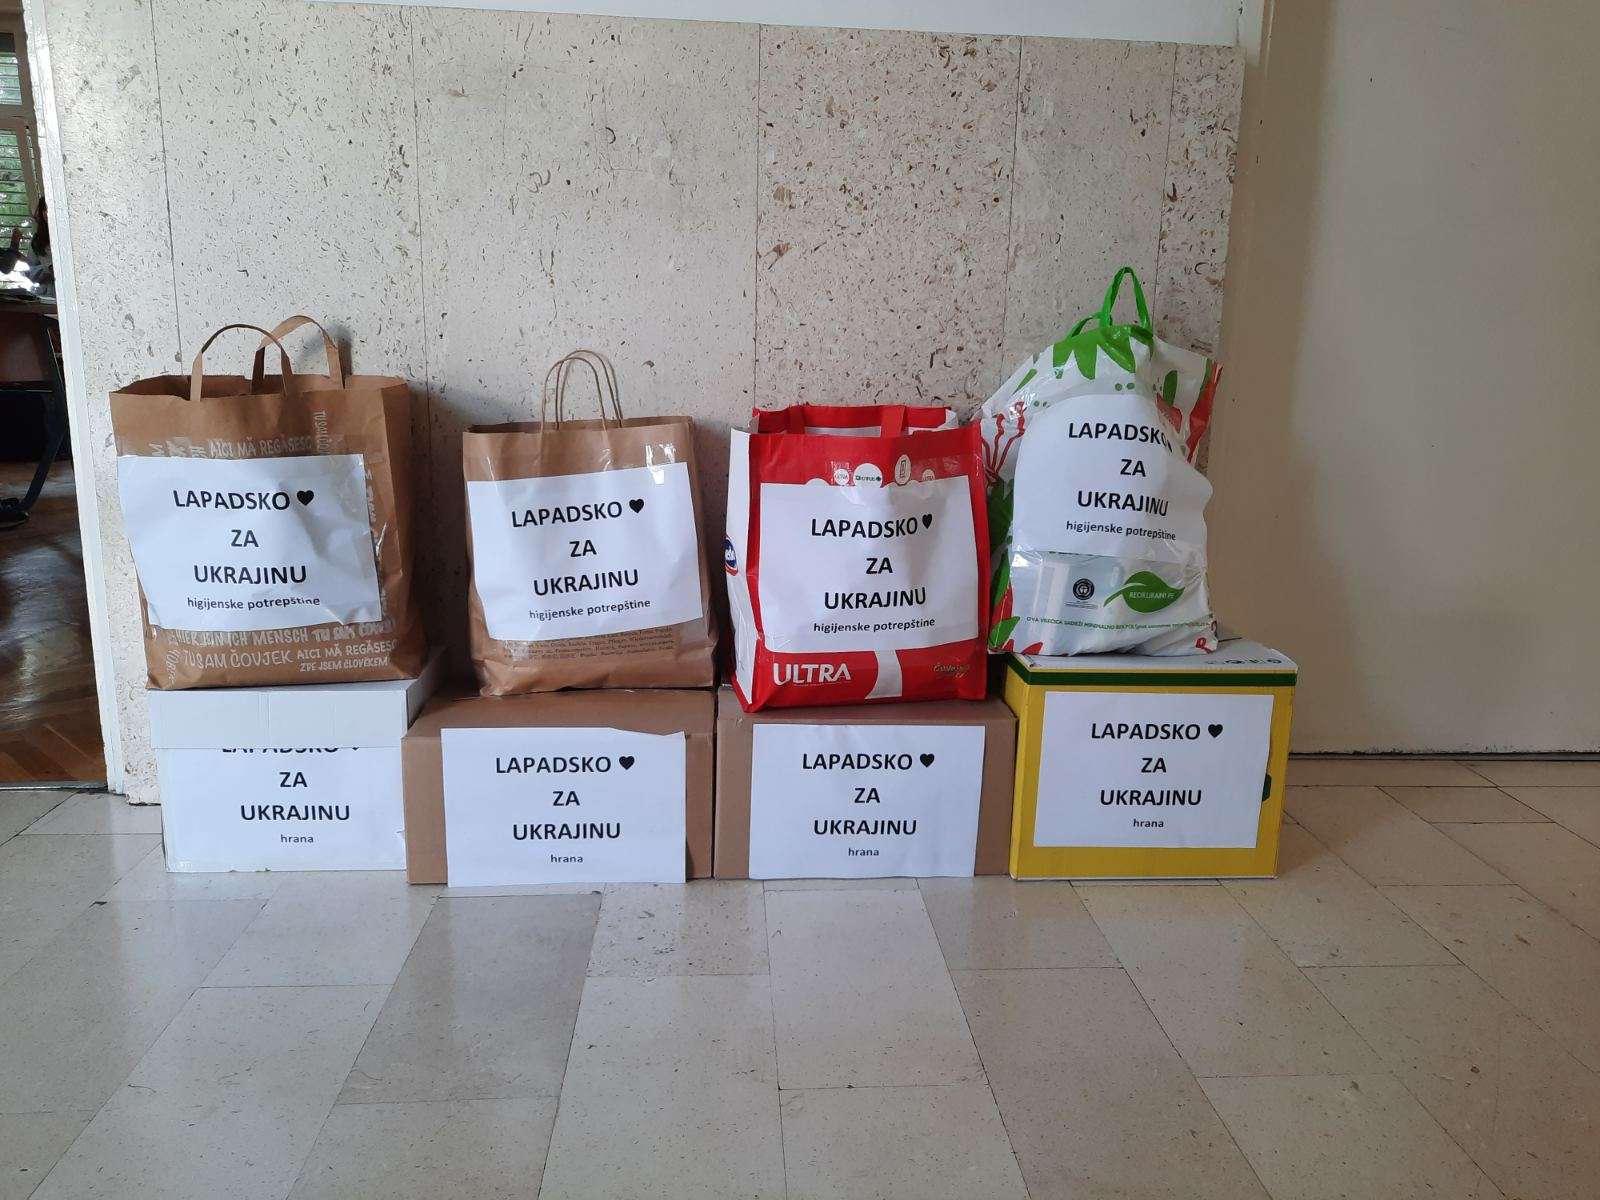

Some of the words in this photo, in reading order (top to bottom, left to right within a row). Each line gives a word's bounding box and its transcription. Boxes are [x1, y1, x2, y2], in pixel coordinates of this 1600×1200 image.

[1119, 458, 1147, 478] ZA
[172, 489, 291, 511] LAPADSKO
[1077, 490, 1169, 517] UKRAJINU
[511, 501, 623, 528] LAPADSKO
[811, 516, 918, 539] LAPADSKO
[1065, 520, 1123, 534] higijenske
[1125, 527, 1177, 543] potrepštine
[230, 528, 260, 548] ZA
[568, 539, 598, 558] ZA
[193, 564, 307, 585] UKRAJINU
[865, 556, 894, 575] ZA
[533, 568, 639, 597] UKRAJINU
[186, 596, 244, 611] higijenske
[824, 586, 927, 610] UKRAJINU
[528, 606, 584, 622] higijenske
[586, 599, 651, 617] potrepštine
[813, 621, 871, 634] higijenske
[872, 617, 937, 633] potrepštine
[252, 628, 309, 646] MENSCH
[230, 647, 294, 669] ČOVJEK
[296, 648, 321, 661] AICI
[772, 662, 852, 687] ULTRA
[1091, 722, 1201, 741] LAPADSKO
[495, 756, 612, 774] LAPADSKO
[802, 752, 913, 771] LAPADSKO
[1140, 757, 1167, 774] ZA
[278, 771, 309, 788] ZA
[552, 790, 581, 807] ZA
[853, 787, 881, 804] ZA
[1100, 789, 1202, 806] UKRAJINU
[240, 804, 350, 821] UKRAJINU
[512, 822, 621, 841] UKRAJINU
[813, 819, 917, 836] UKRAJINU
[1132, 818, 1165, 828] hrana
[280, 833, 314, 844] hrana
[550, 853, 584, 864] hrana
[847, 847, 880, 857] hrana
